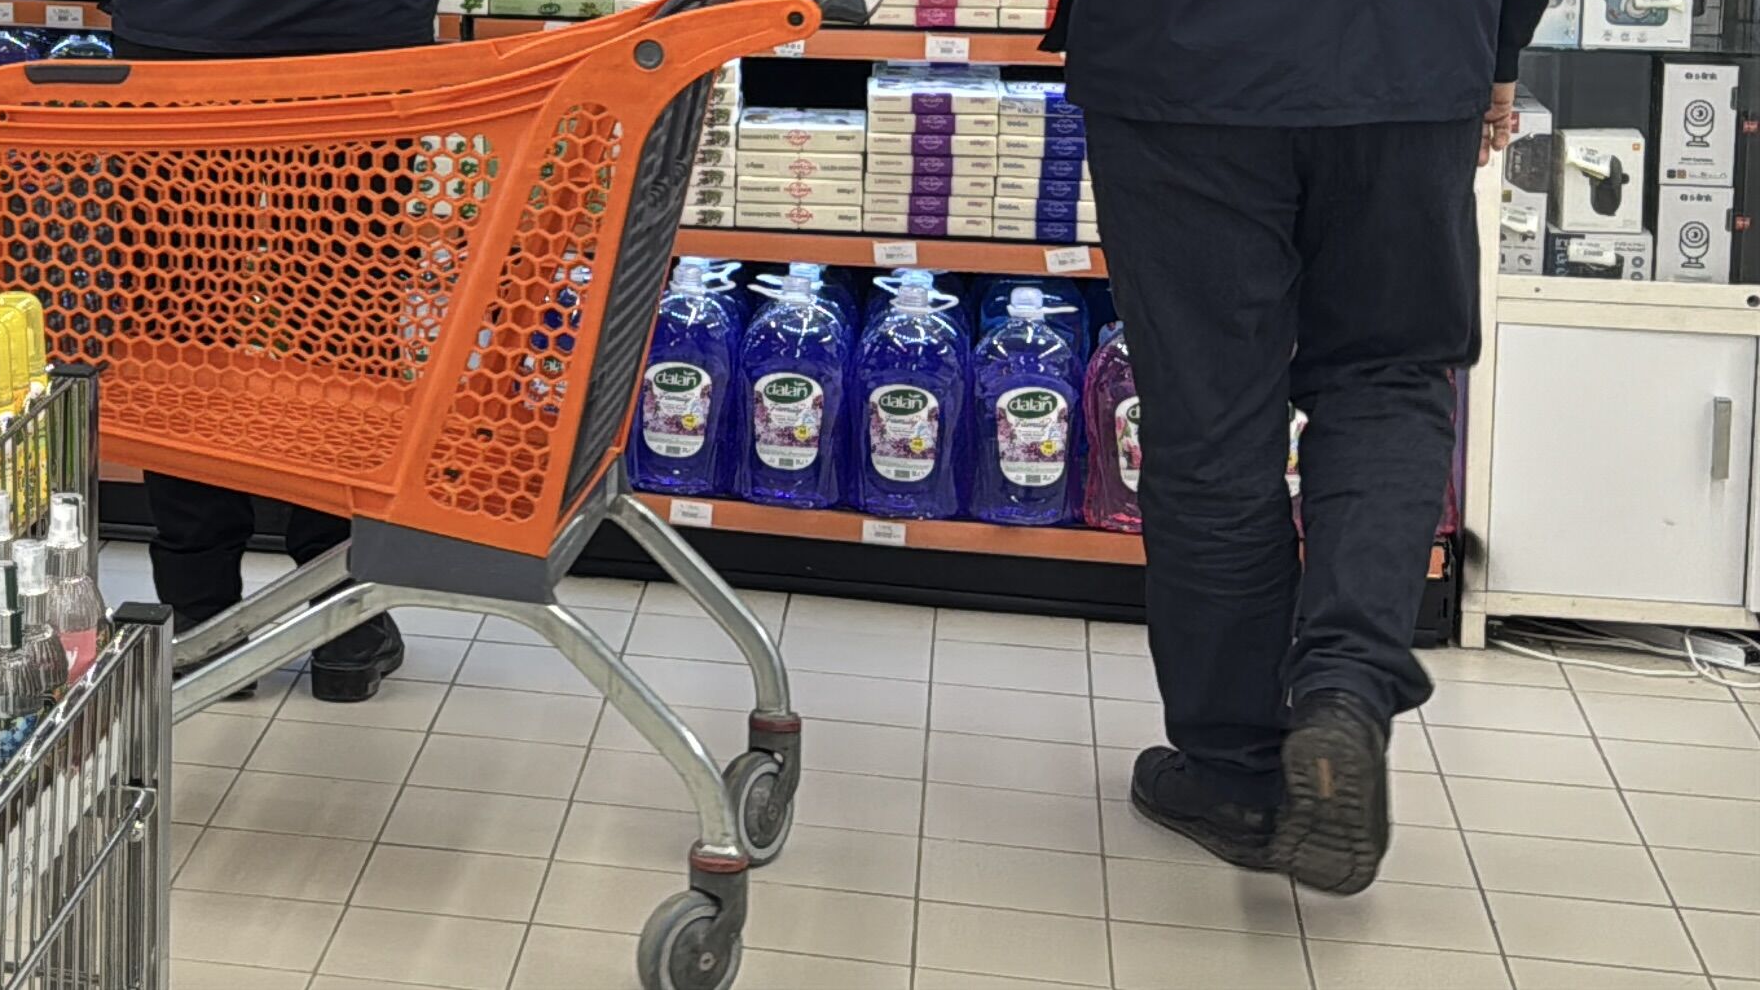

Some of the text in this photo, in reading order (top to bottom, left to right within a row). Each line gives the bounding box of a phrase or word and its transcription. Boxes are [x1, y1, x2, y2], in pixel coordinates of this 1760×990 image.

[655, 369, 697, 387] dalan
[765, 381, 808, 398] dalan
[880, 393, 924, 410] dalan
[1009, 395, 1053, 412] dalan
